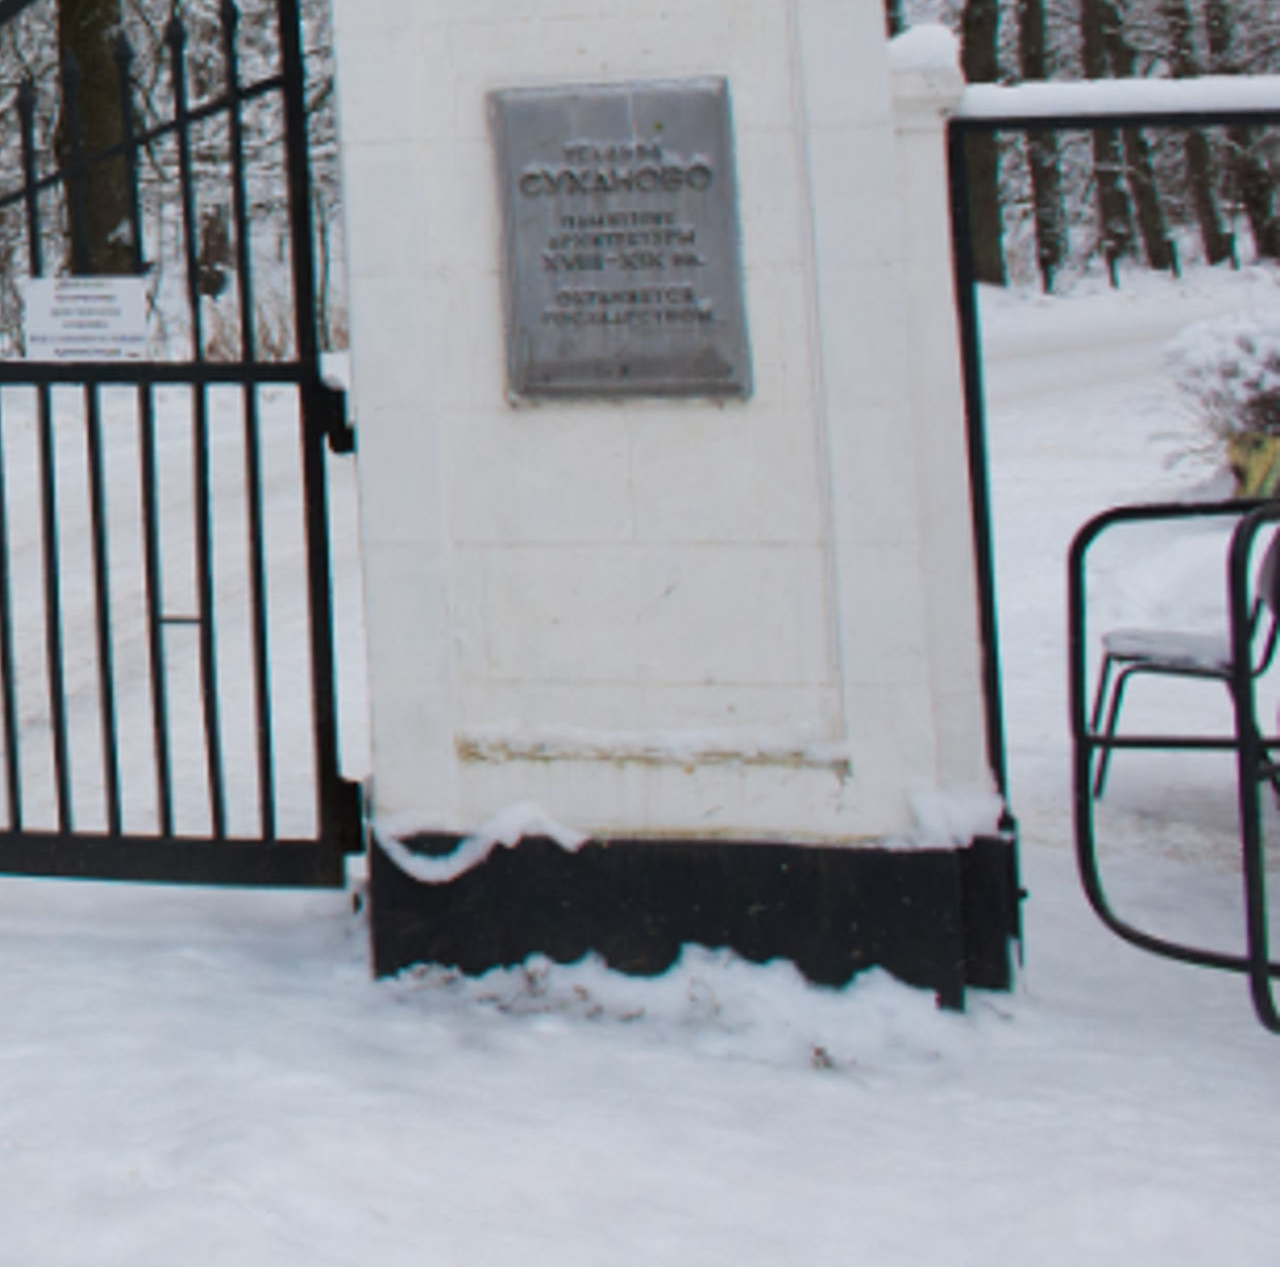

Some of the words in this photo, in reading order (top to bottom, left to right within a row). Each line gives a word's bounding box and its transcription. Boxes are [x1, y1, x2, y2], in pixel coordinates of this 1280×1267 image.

[519, 163, 713, 198] СУХАНОВО
[560, 211, 675, 229] ПАМЯТНИК
[548, 229, 696, 250] АРХИТЕКТУРЫ
[554, 285, 694, 308] ОХРАНЯЕТСЯ
[541, 307, 714, 326] ГОСУДАРСТВОМ
